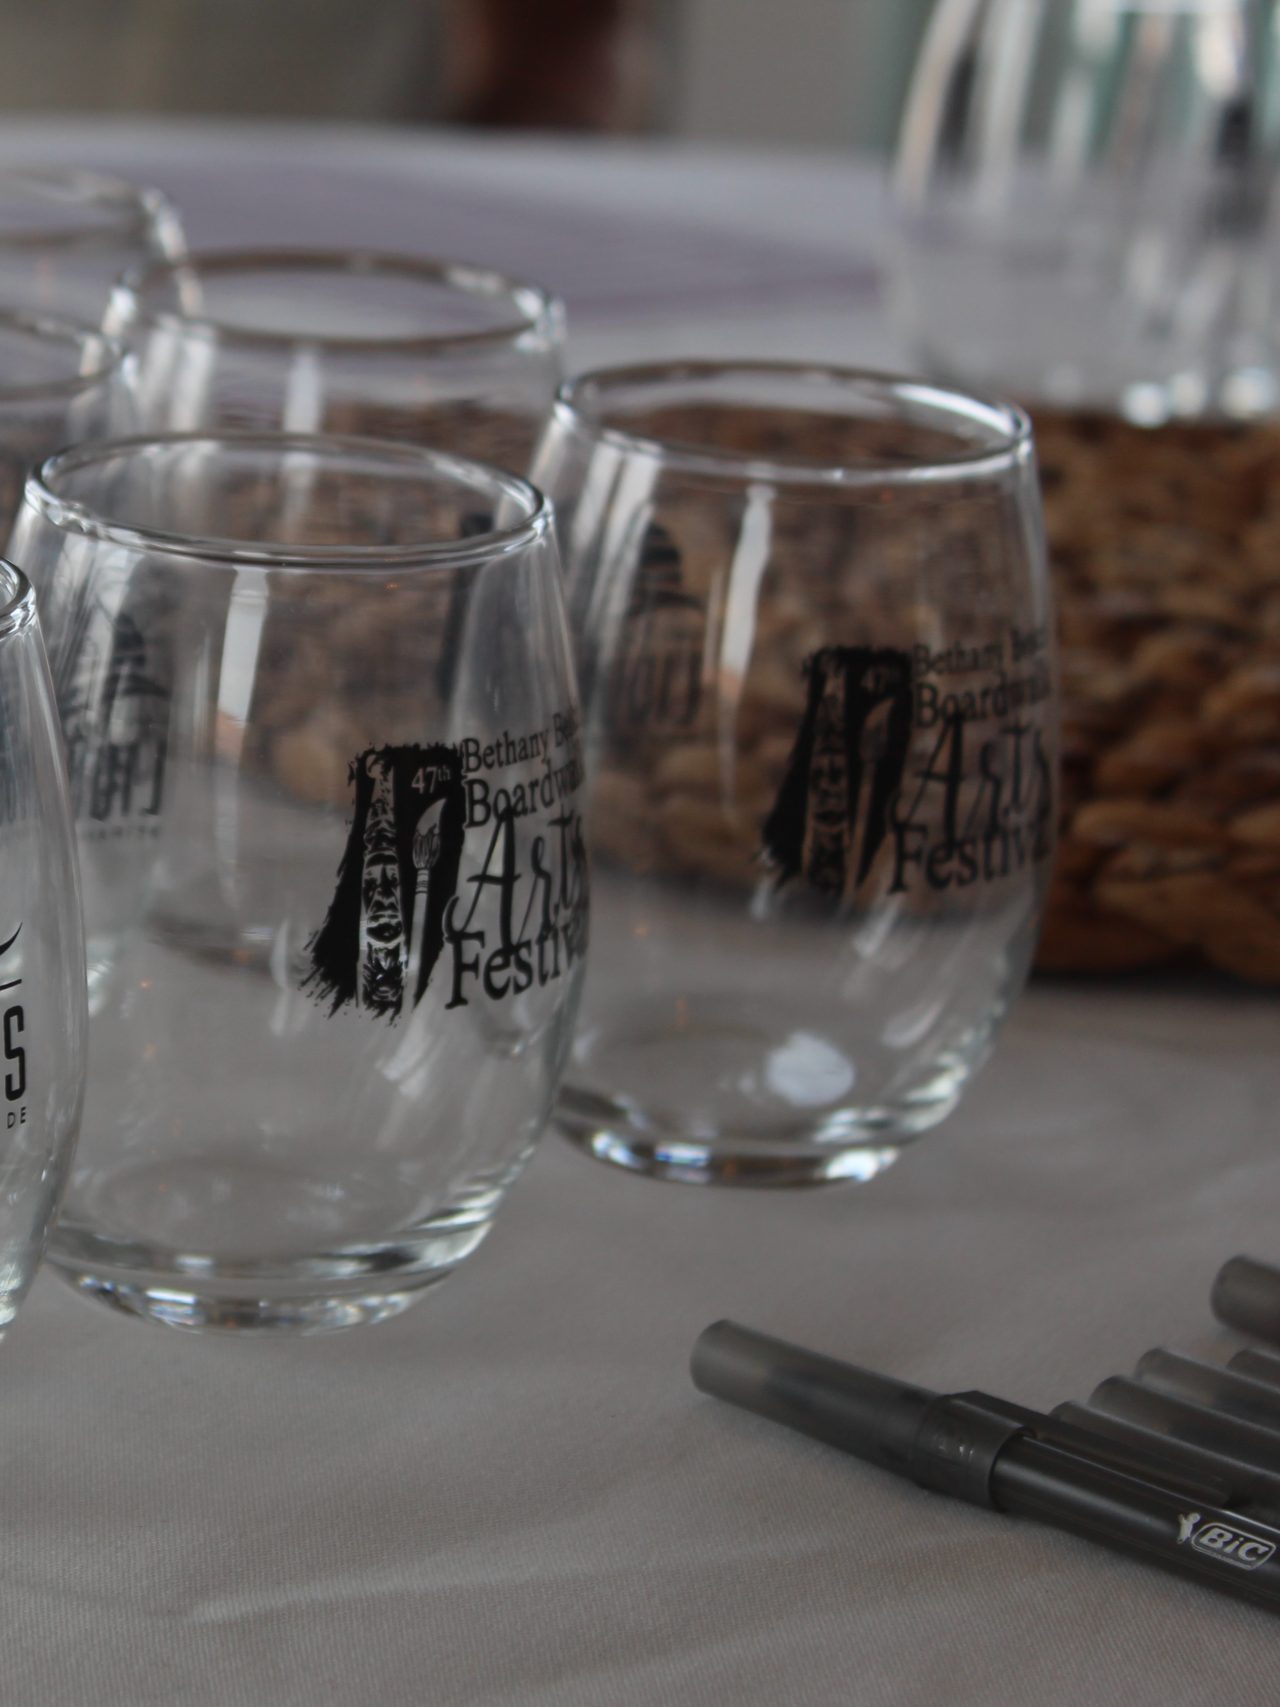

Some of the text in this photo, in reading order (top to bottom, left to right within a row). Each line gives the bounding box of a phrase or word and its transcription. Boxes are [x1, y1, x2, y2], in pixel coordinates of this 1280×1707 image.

[462, 728, 551, 774] Bethany
[411, 765, 451, 794] 47th
[7, 1106, 27, 1129] DE
